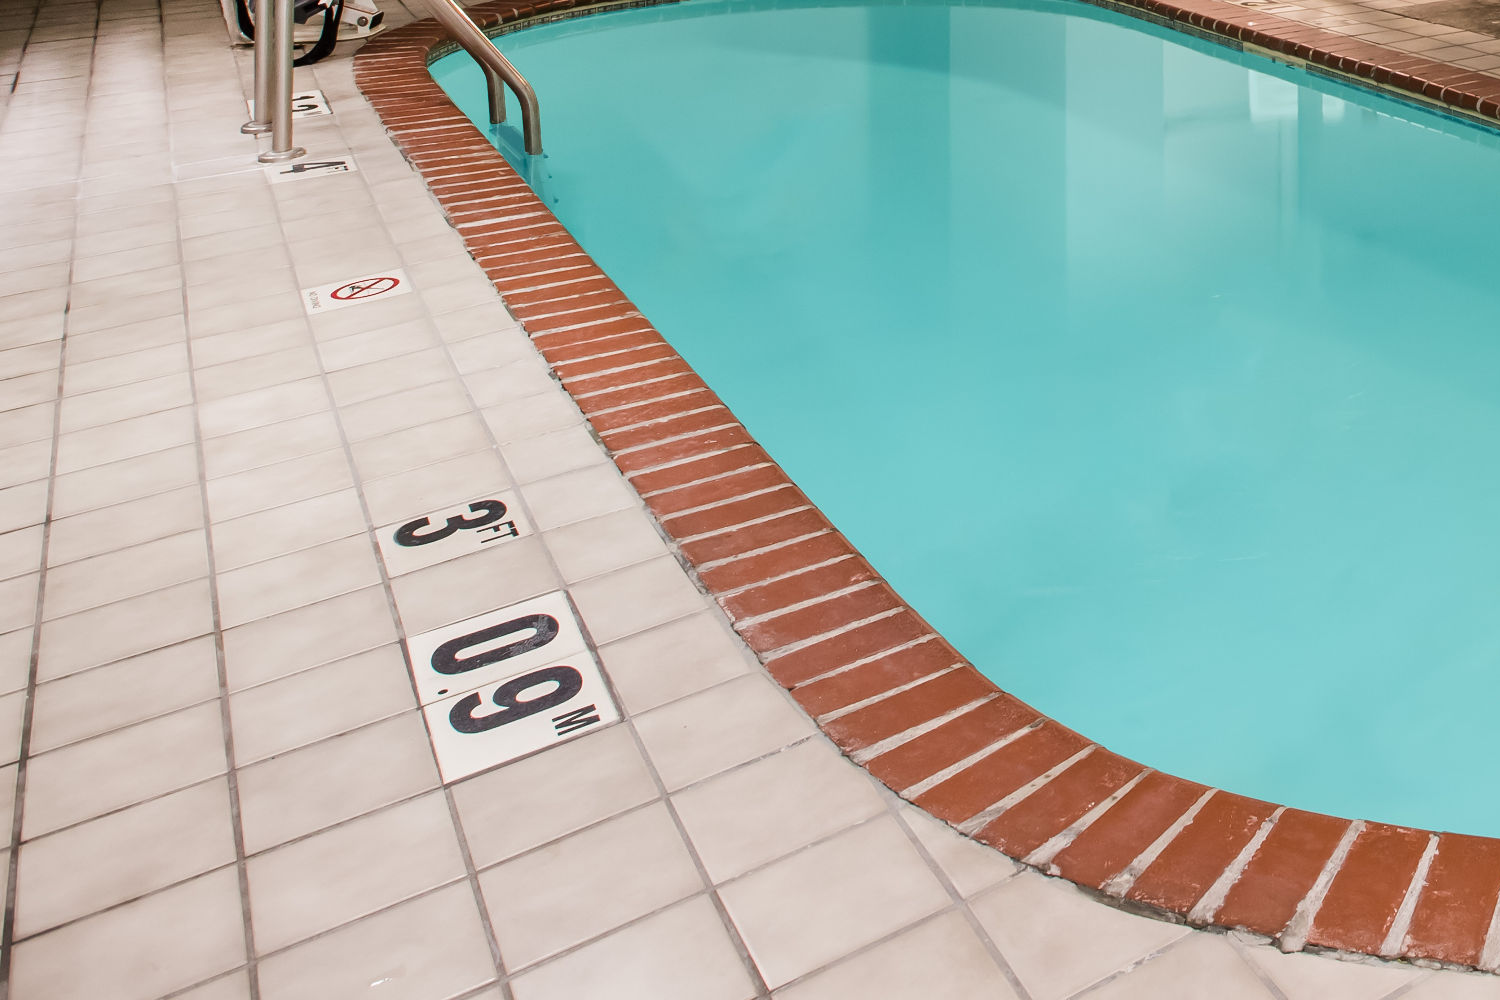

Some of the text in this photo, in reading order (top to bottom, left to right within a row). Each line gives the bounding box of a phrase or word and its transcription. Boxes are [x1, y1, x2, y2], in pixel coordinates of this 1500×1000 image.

[280, 160, 346, 175] 4
[393, 499, 520, 547] 3 FT
[430, 613, 602, 737] 0.9 M
